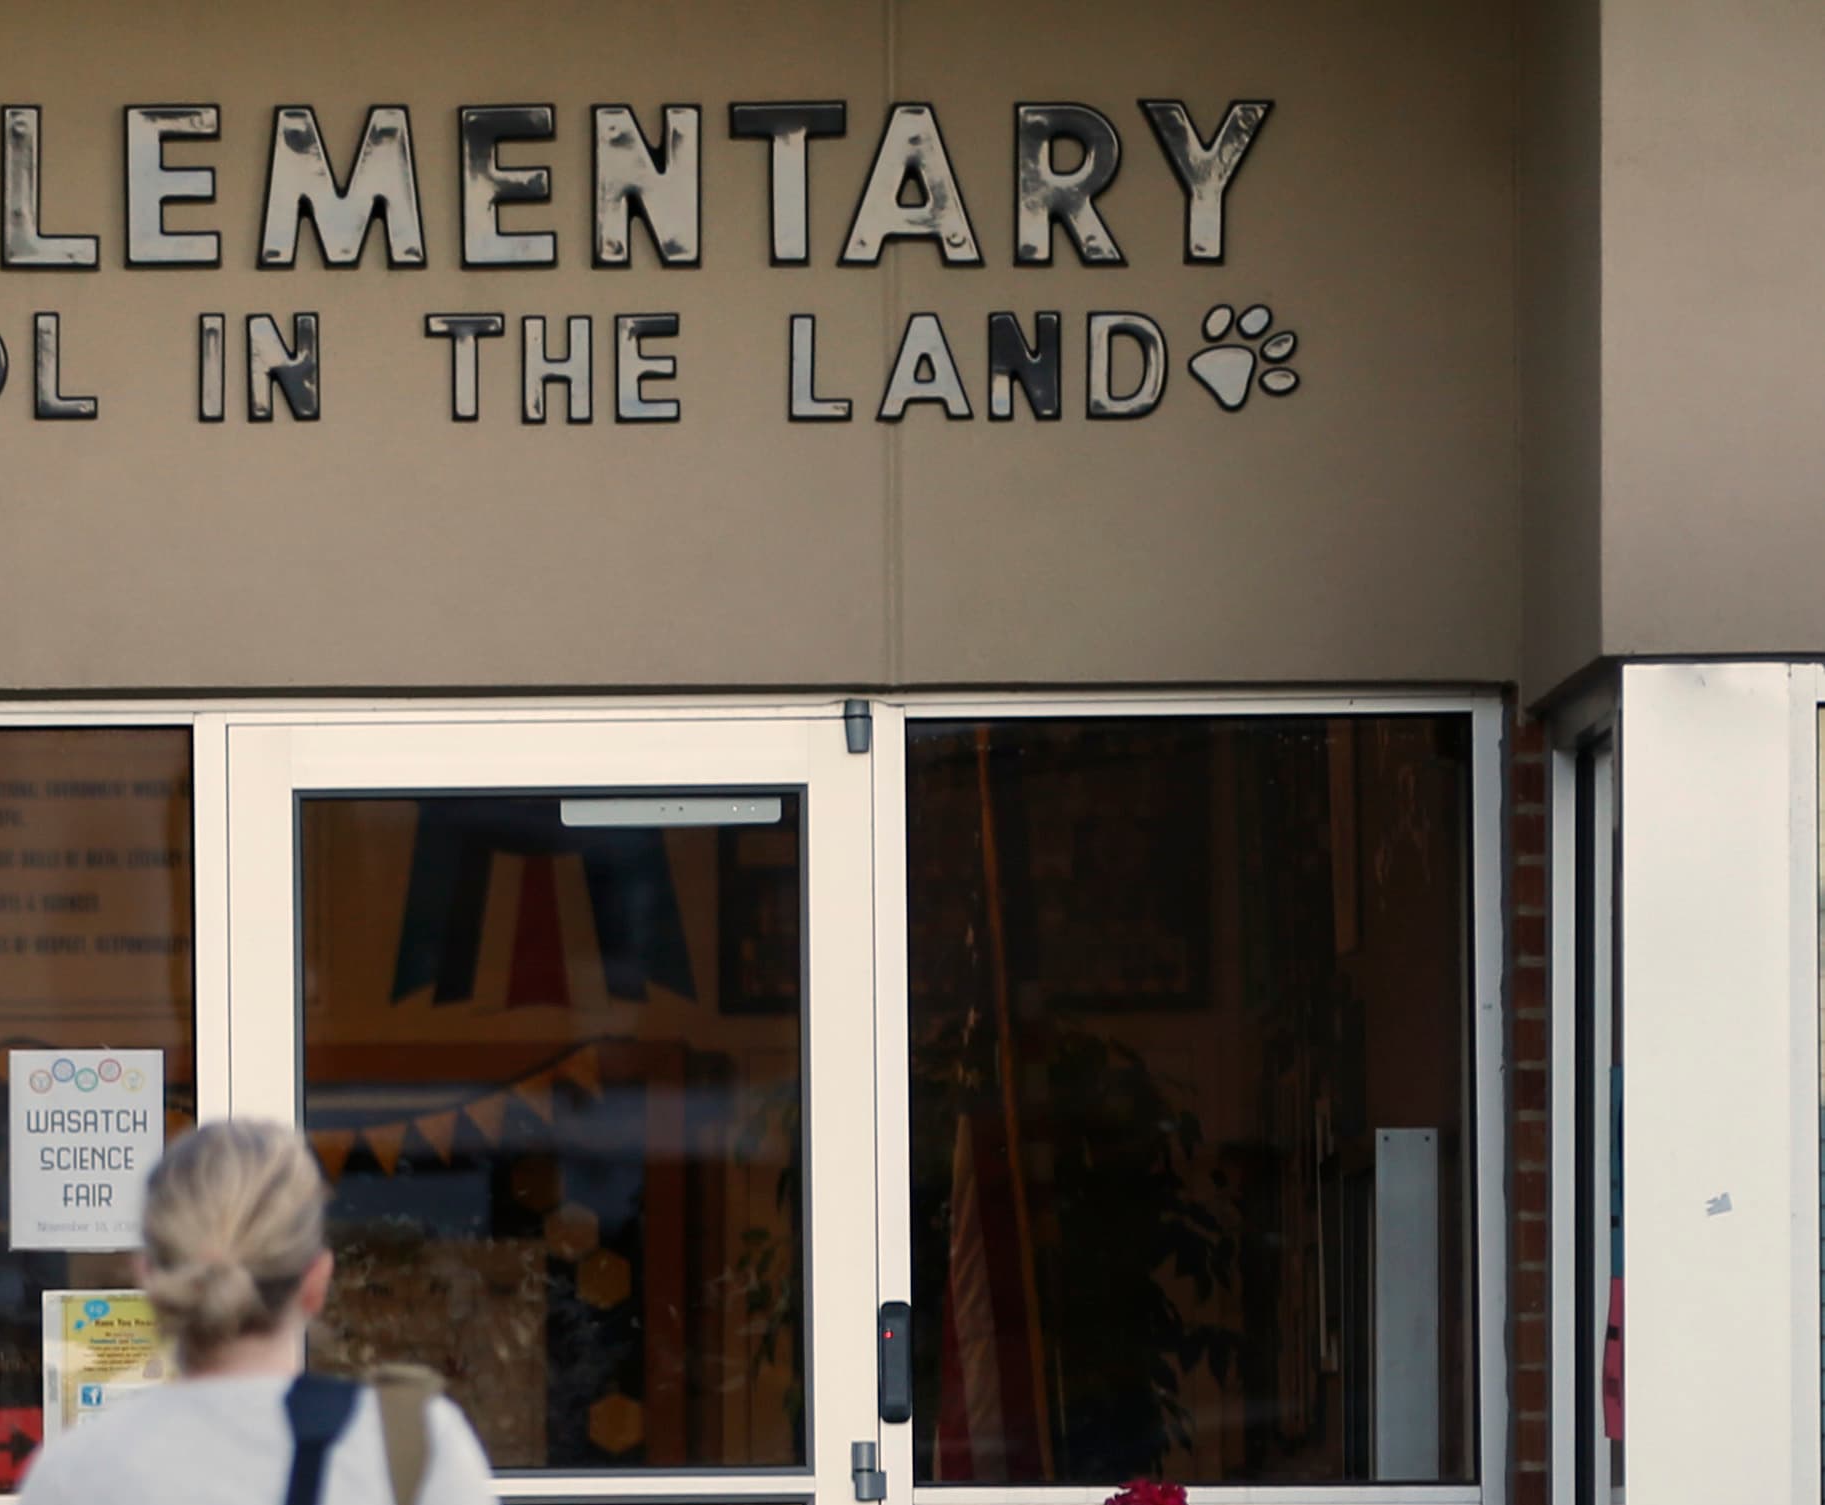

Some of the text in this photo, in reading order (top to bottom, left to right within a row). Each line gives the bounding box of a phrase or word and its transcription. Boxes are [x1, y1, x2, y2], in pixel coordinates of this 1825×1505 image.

[197, 312, 321, 424] IN
[424, 312, 681, 425] THE
[787, 311, 1170, 425] LAND
[26, 1109, 148, 1134] WASATCH
[40, 1146, 135, 1171] SCIENCE
[62, 1183, 113, 1208] FAIR
